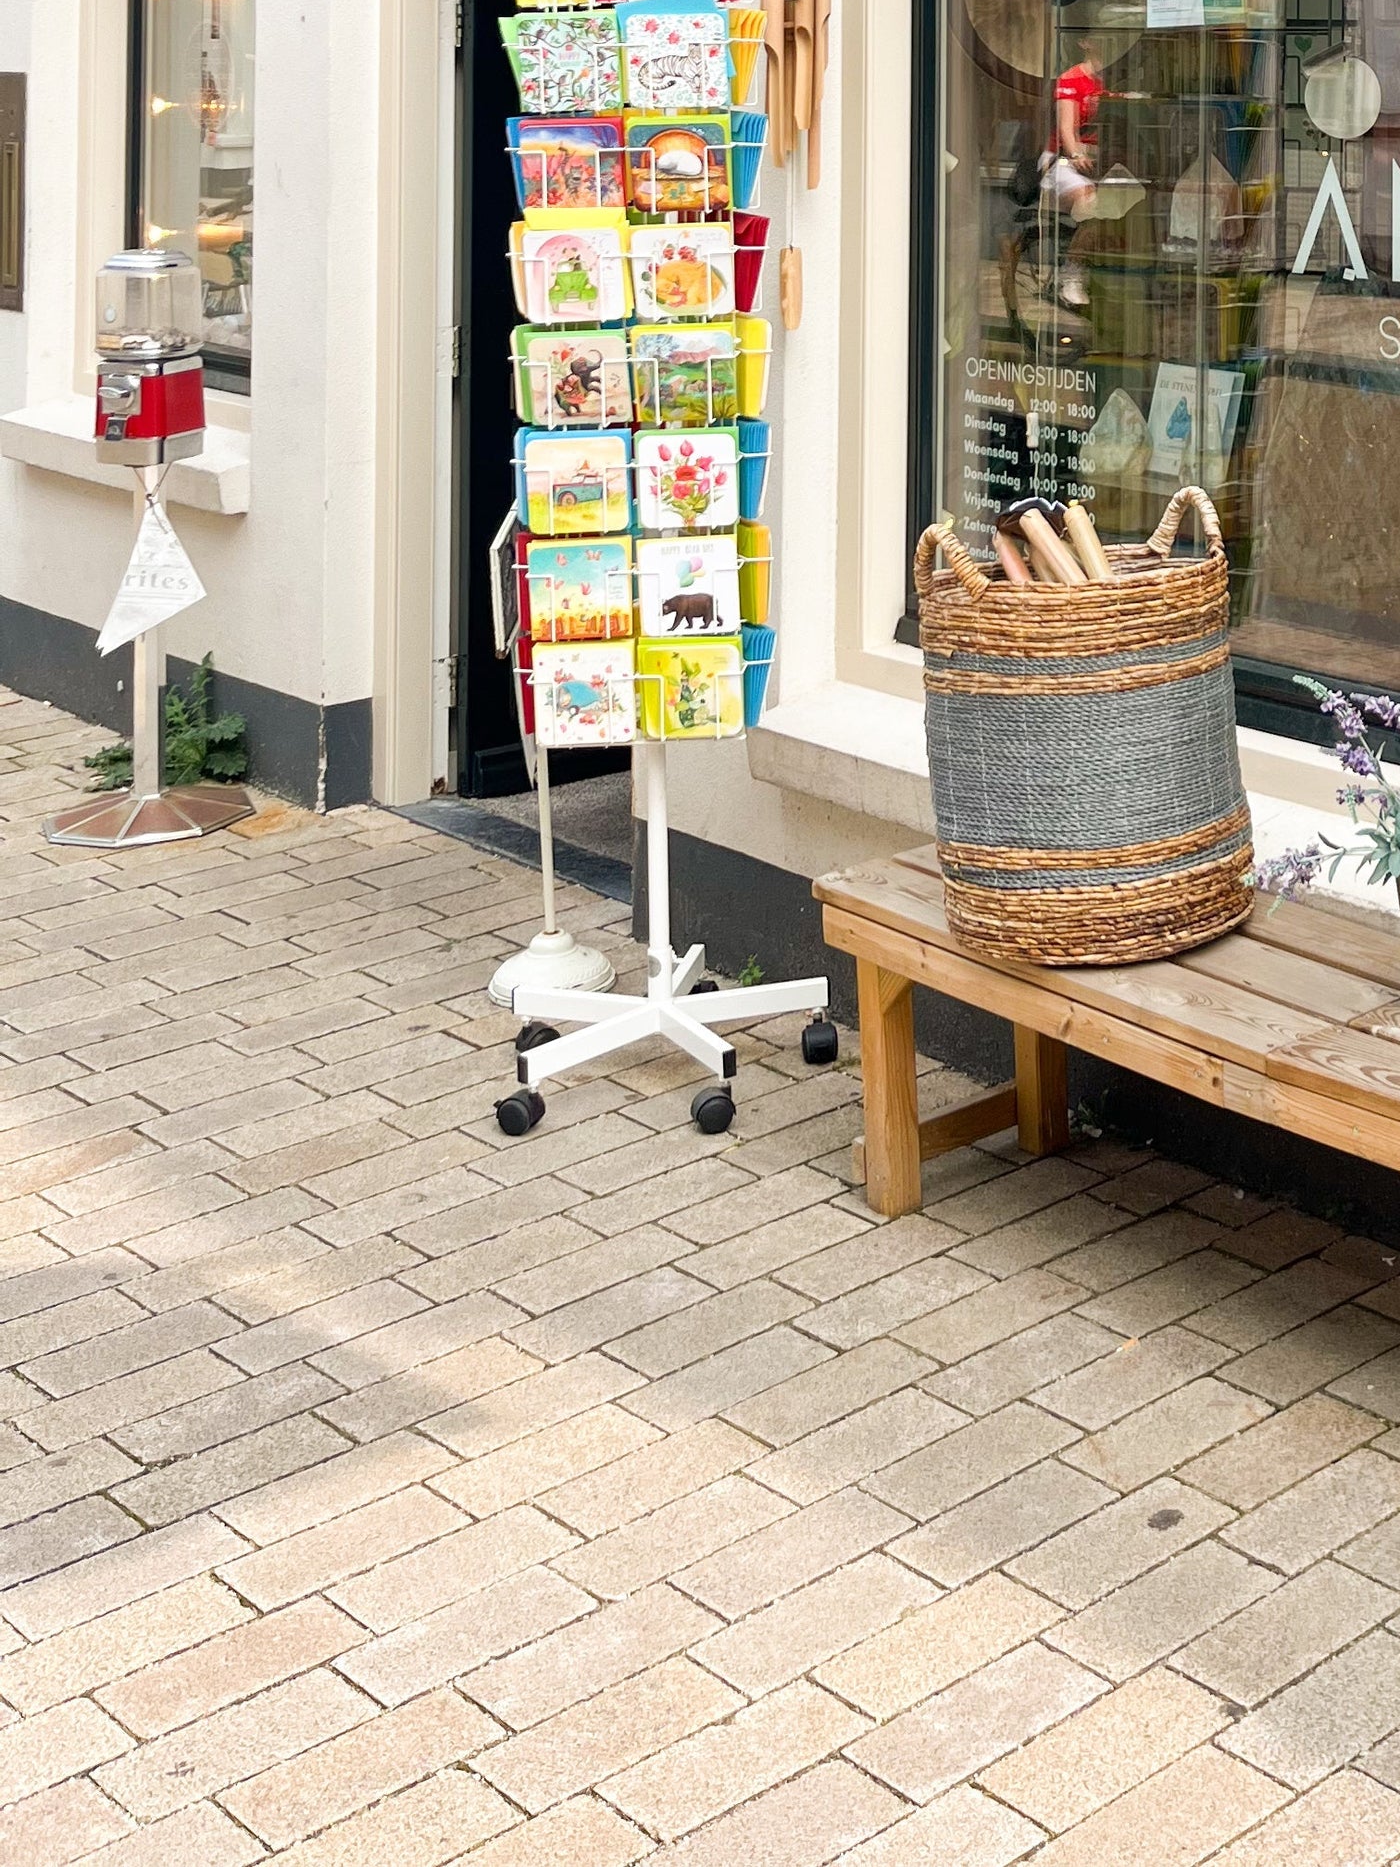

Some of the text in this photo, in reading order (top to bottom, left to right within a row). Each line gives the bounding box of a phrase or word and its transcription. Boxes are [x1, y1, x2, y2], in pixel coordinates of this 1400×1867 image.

[965, 356, 1097, 393] OPENINGSTIJDEN
[964, 388, 1015, 412] Maandag
[1029, 398, 1058, 414] 12:00
[1066, 403, 1097, 420] 18:00
[964, 414, 1007, 437] Dinsdag
[1066, 429, 1097, 446] 18:00
[963, 439, 1019, 465] Woensdag
[1029, 450, 1058, 467] 10:00
[1066, 455, 1097, 473] 18:00
[963, 465, 1021, 491] Donderdag
[1029, 476, 1058, 494] 10:00
[1066, 482, 1096, 500] 18:00
[963, 490, 1001, 514] Vrijdag
